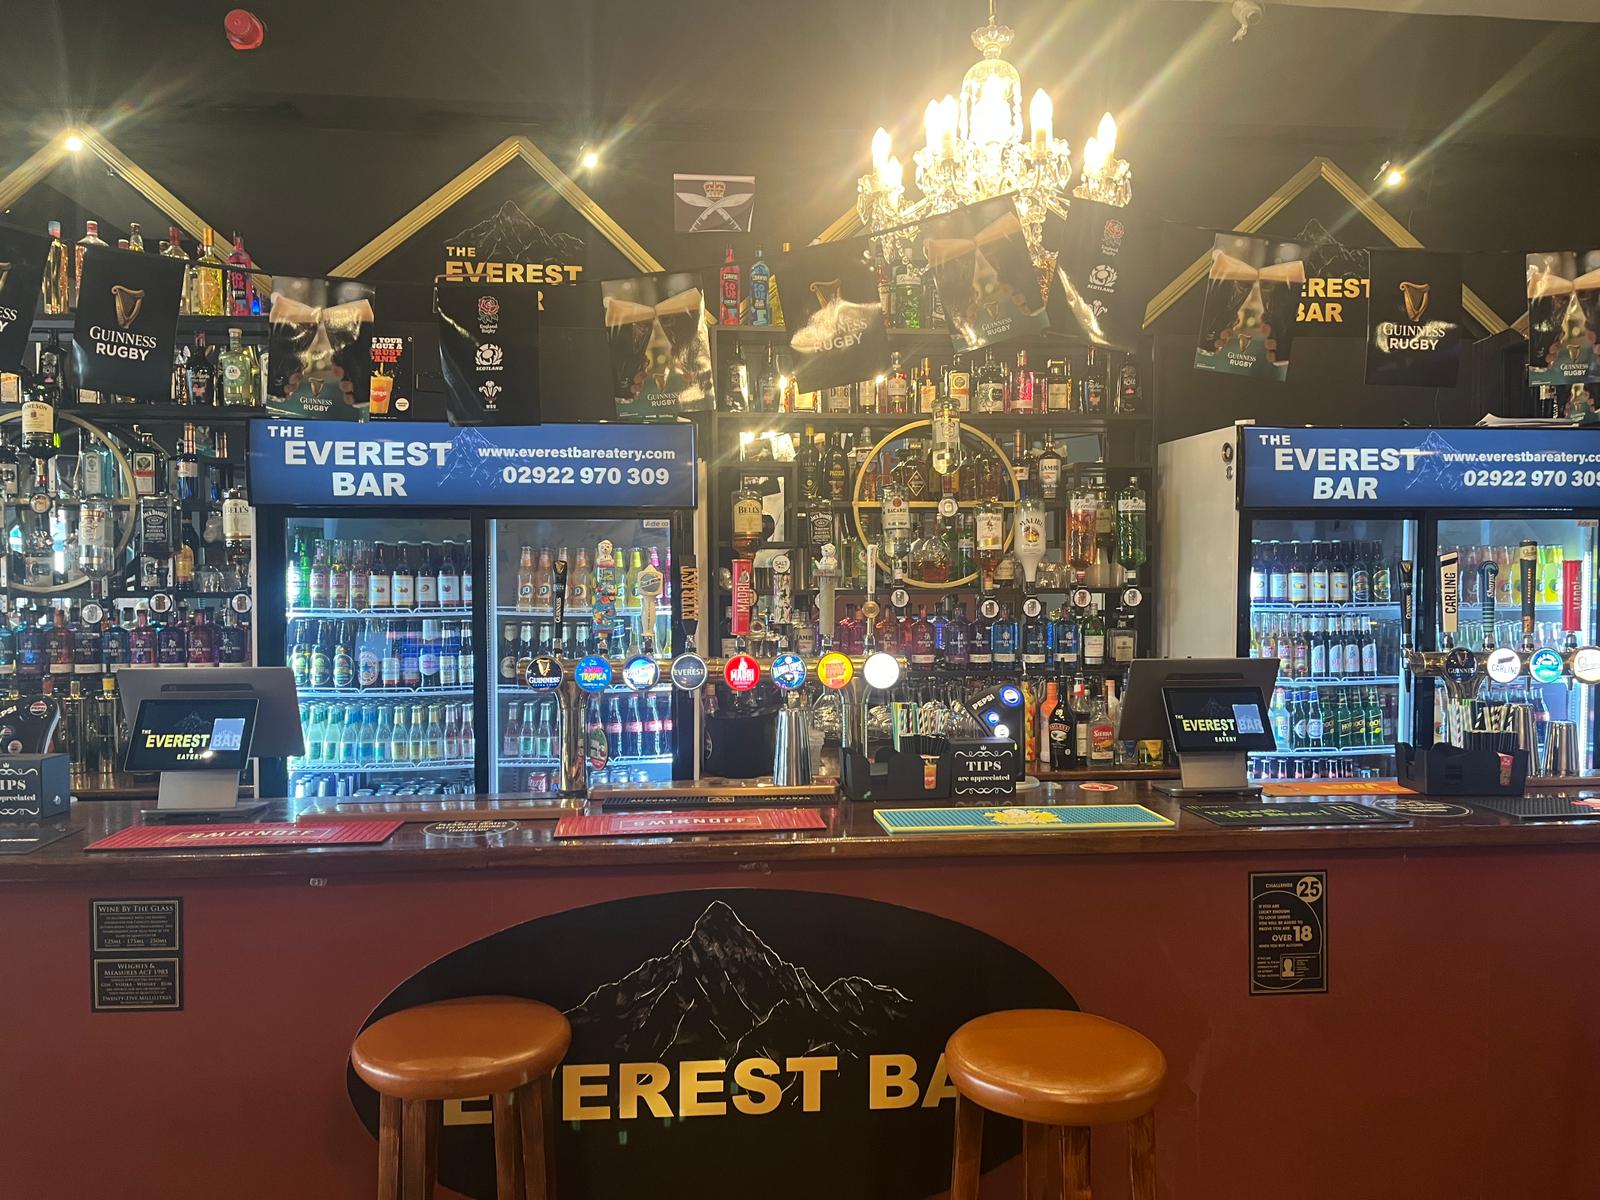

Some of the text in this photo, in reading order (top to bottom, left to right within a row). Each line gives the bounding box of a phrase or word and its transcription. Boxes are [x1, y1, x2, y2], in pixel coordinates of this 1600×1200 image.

[446, 246, 476, 257] THE
[445, 261, 583, 285] EVEREST
[1300, 277, 1371, 299] REST
[982, 318, 1012, 331] GUINNESS
[987, 324, 1010, 336] RUGBY
[1383, 322, 1445, 339] GUINNESS
[89, 325, 157, 350] GUINNESS
[813, 332, 862, 353] RUGBY
[1389, 337, 1439, 351] RUGBY
[95, 341, 150, 362] RUGBY
[1227, 350, 1257, 362] GUINNESS
[1229, 358, 1253, 368] RUGBY
[1560, 363, 1589, 371] GUINNESS
[299, 395, 333, 407] GUINNESS
[647, 393, 680, 402] GUINNESS
[303, 403, 329, 412] RUGBY
[268, 426, 304, 438] THE
[1259, 435, 1291, 446] THE
[284, 441, 453, 466] EVEREST
[478, 446, 676, 462] www.everestbareatery.com
[1274, 448, 1420, 471] EVEREST
[1443, 451, 1600, 466] www.everestbareatery.co
[503, 466, 670, 485] 02922 970 309
[1464, 471, 1528, 487] 02922
[1531, 471, 1568, 487] 970
[333, 472, 407, 497] BAR
[1313, 477, 1378, 500] BAR
[775, 560, 788, 568] SALT
[1445, 572, 1457, 614] CARLING
[579, 672, 607, 682] TROPICA
[674, 668, 705, 677] EVEREST
[528, 676, 561, 684] GUINNESS
[972, 693, 996, 711] PEPSI
[1182, 719, 1263, 731] EVEREST BAR
[145, 735, 241, 748] EVEREST BAR
[965, 760, 1001, 772] TIPS
[970, 773, 1010, 782] appreciated
[0, 779, 27, 791] IPS
[635, 817, 749, 827] SMIRNOFF
[188, 829, 315, 840] SMIRNOFF
[1299, 881, 1320, 898] 25
[98, 904, 174, 913] WINE BY THE GLASS
[1272, 925, 1313, 942] OVER 18
[443, 1053, 964, 1127] EEREST BA
